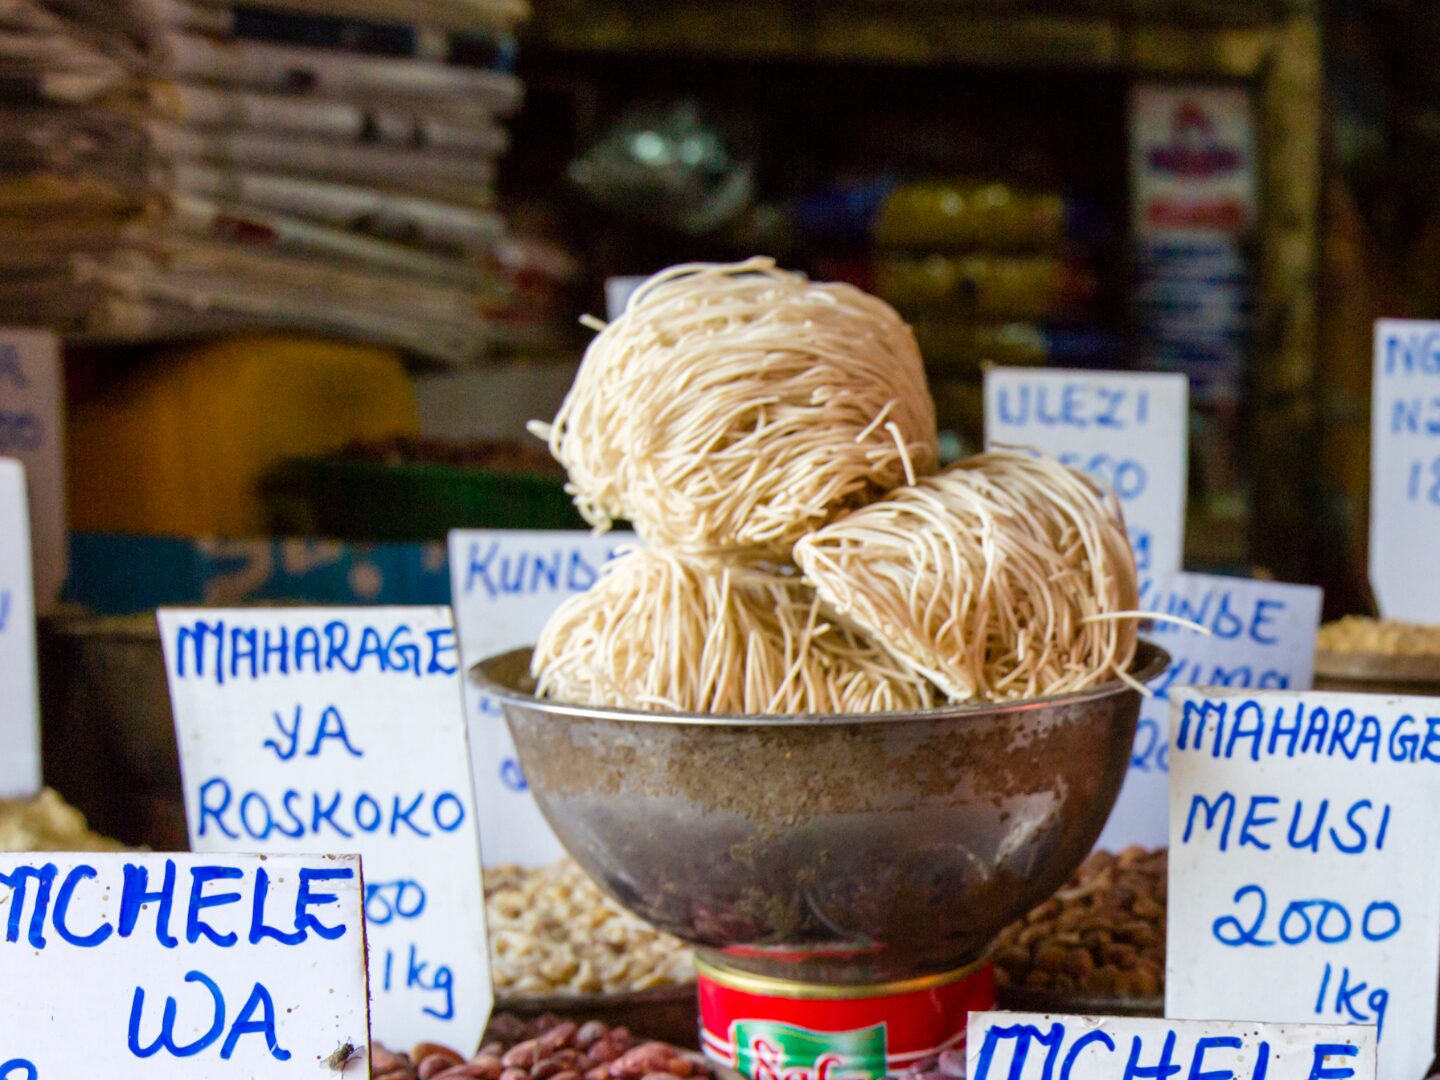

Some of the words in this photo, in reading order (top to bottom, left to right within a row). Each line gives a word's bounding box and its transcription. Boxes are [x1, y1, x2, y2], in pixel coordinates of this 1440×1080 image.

[996, 382, 1149, 430] ULEZI
[466, 540, 633, 598] KUND
[176, 620, 458, 686] MAHARAGE
[263, 703, 364, 763] YA
[197, 777, 467, 841] ROSKOKO
[1182, 790, 1392, 855] MEUSI
[1212, 884, 1402, 947] 2000
[128, 970, 292, 1061] WA
